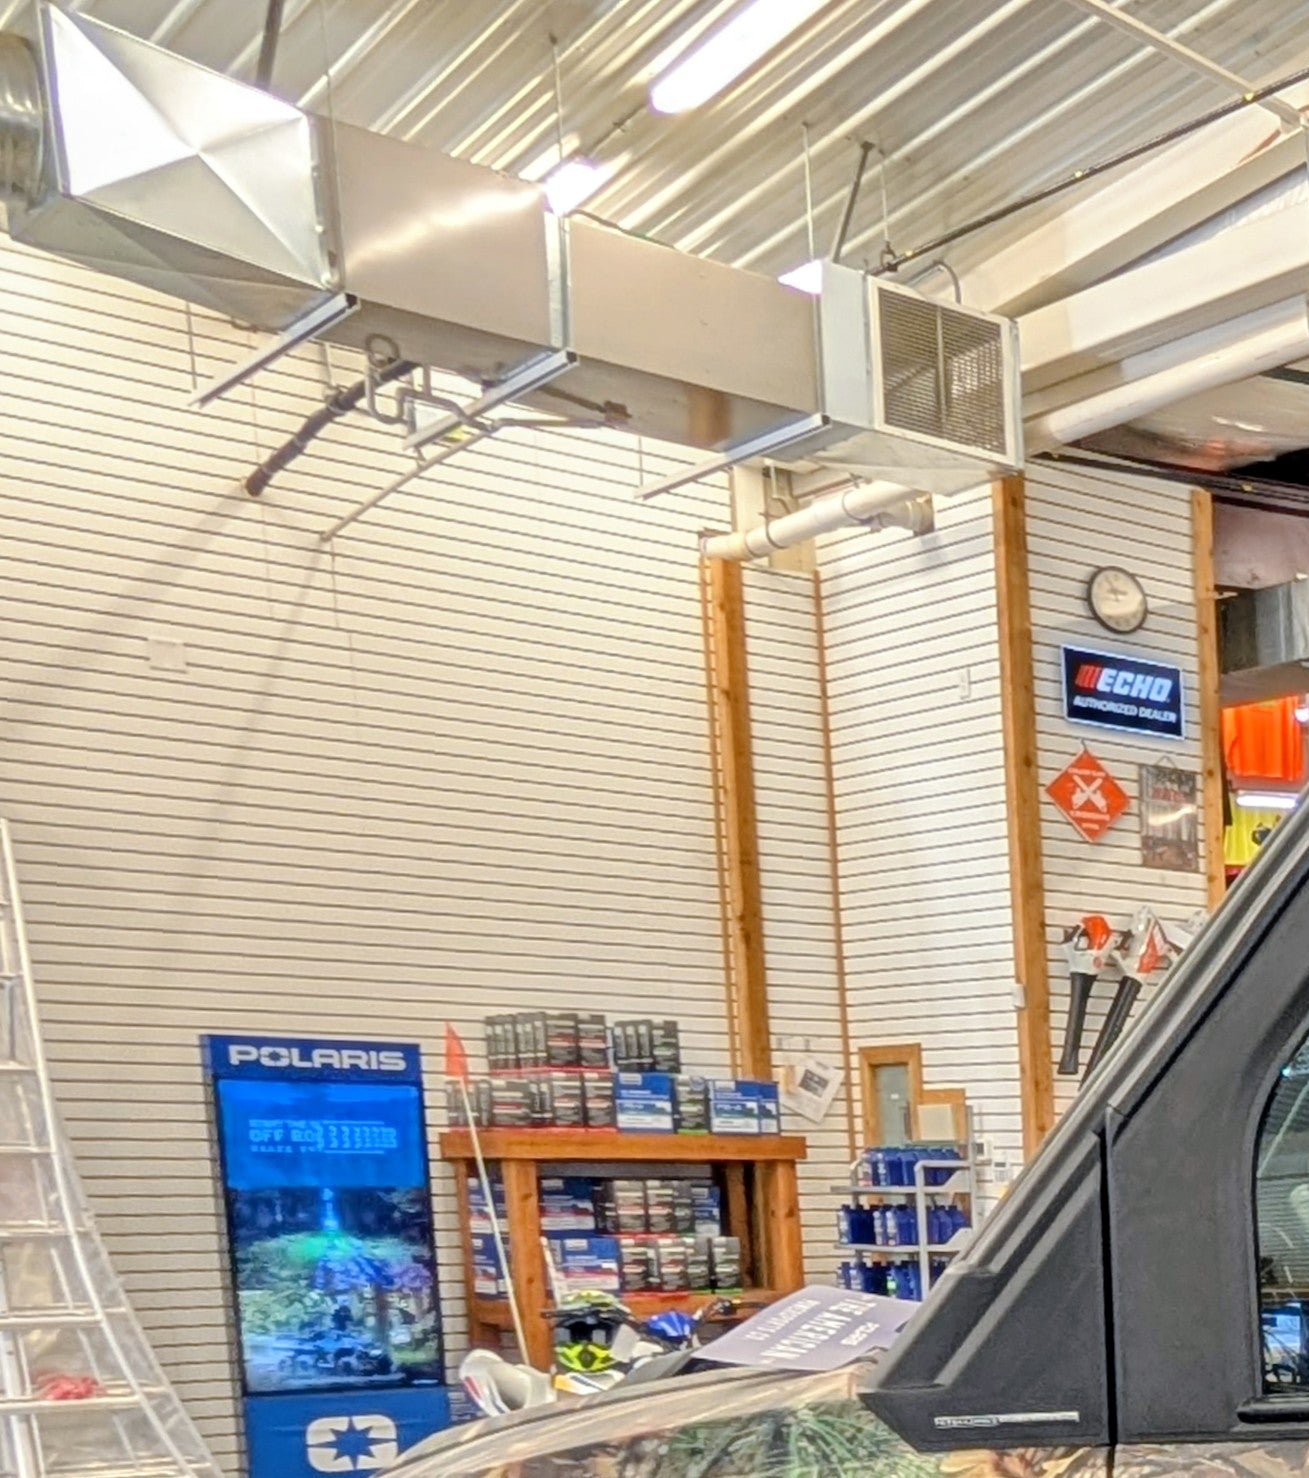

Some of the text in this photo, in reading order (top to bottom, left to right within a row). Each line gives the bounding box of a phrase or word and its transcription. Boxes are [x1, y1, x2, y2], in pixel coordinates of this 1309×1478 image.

[1096, 667, 1173, 702] ECHO
[1073, 695, 1177, 724] AUTHORIZED DEALER
[228, 1045, 407, 1071] POLARIS
[760, 1311, 853, 1360] AMERICAN
